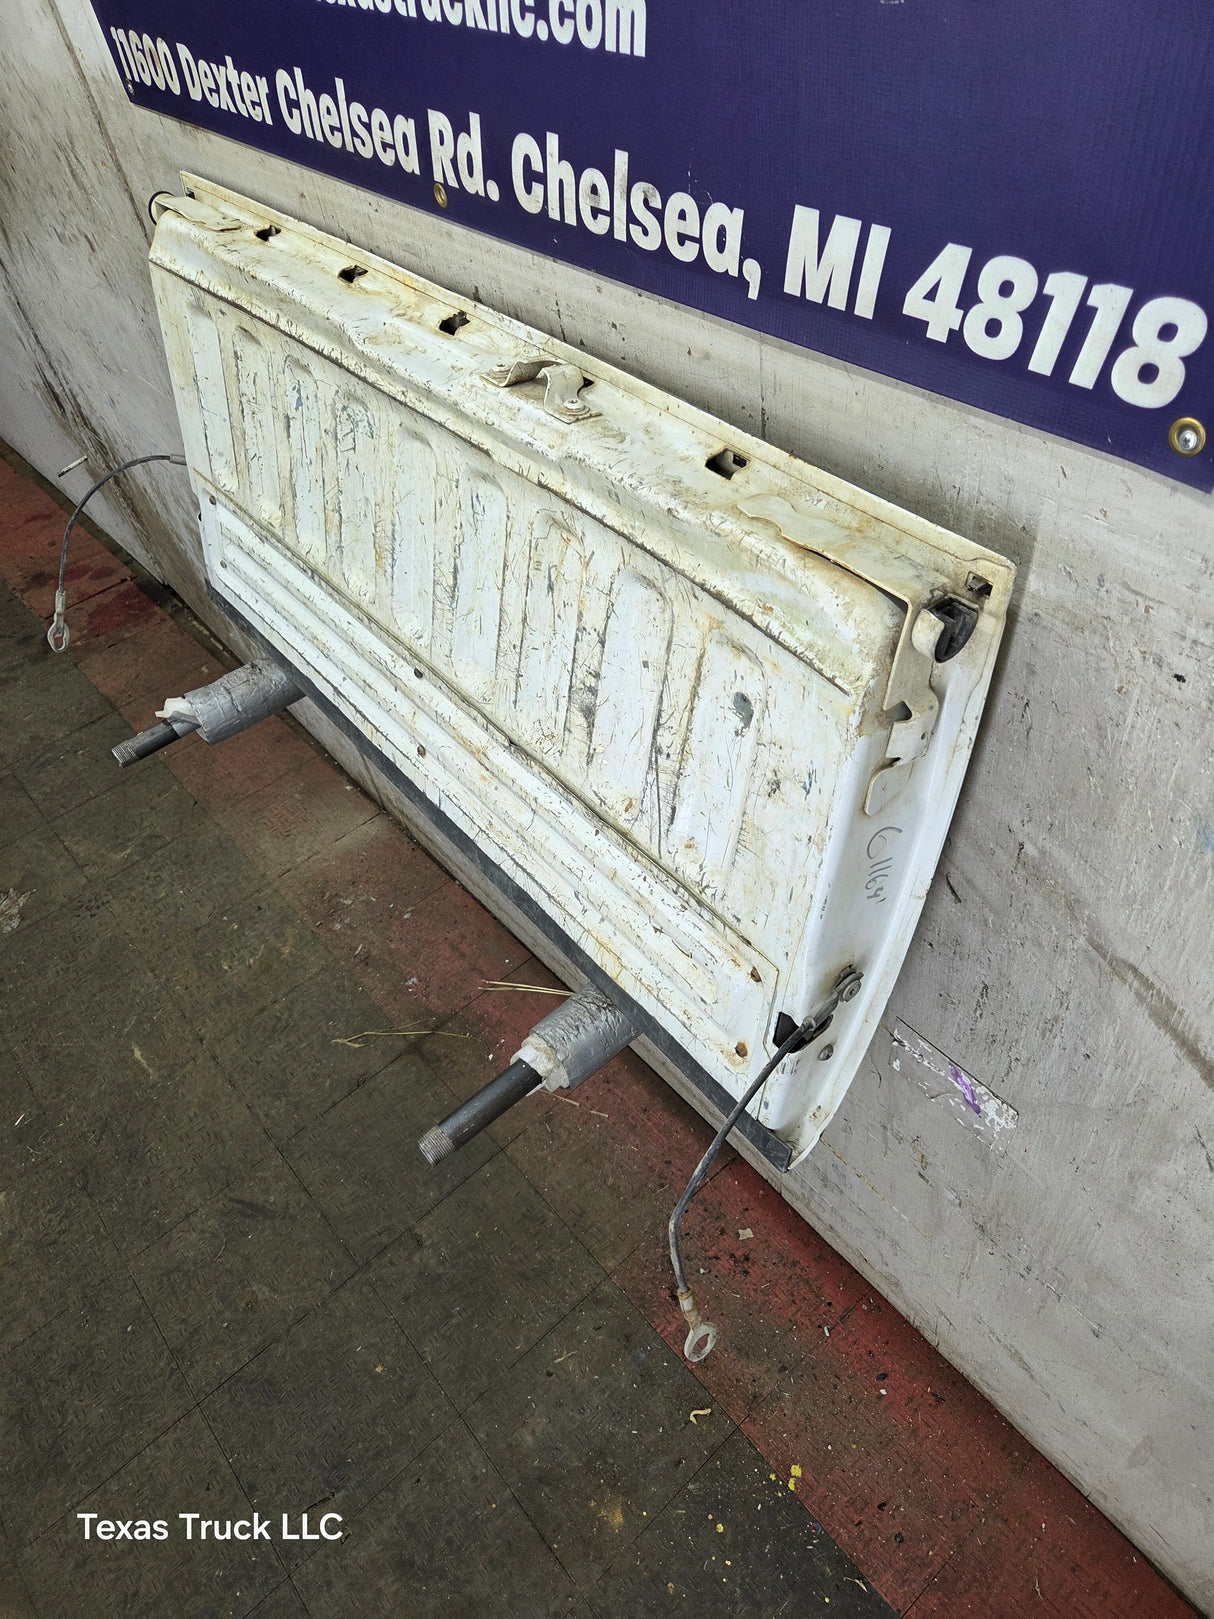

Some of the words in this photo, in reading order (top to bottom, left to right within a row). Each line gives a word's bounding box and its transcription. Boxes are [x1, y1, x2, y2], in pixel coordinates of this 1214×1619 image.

[110, 27, 181, 95] 11600
[176, 43, 274, 125] Dexter
[276, 67, 420, 175] Chelsea
[428, 109, 500, 201] Rd.
[512, 132, 762, 301] Chelsea,
[784, 204, 892, 320] MI
[903, 243, 1207, 408] 48118
